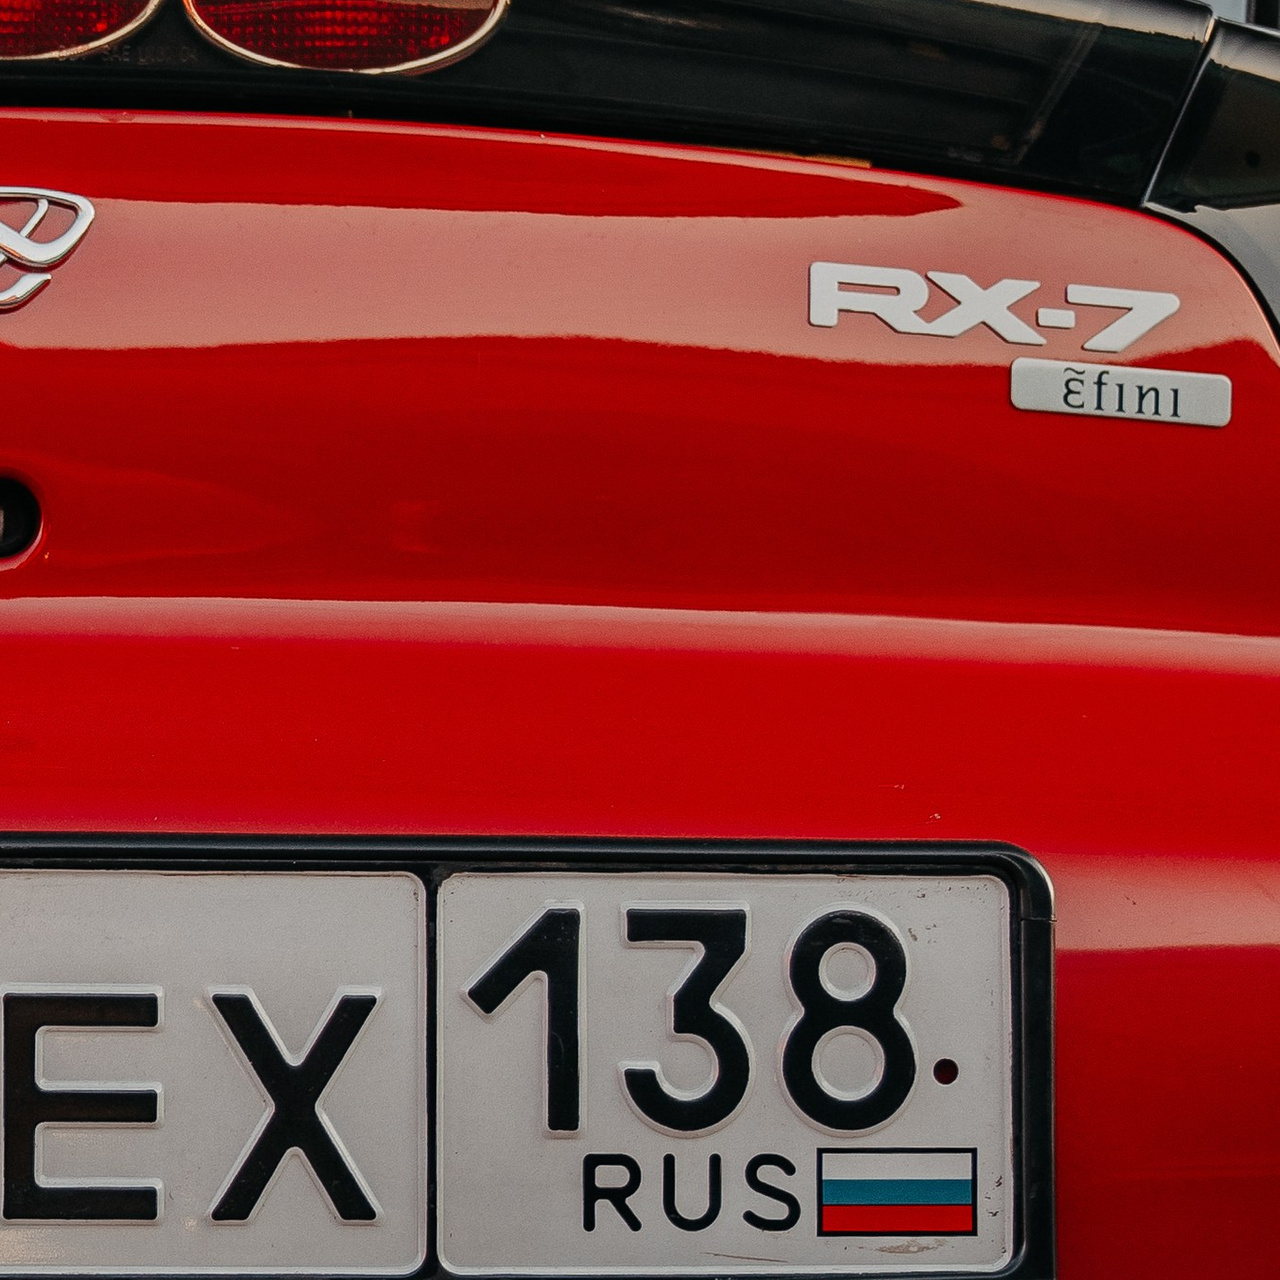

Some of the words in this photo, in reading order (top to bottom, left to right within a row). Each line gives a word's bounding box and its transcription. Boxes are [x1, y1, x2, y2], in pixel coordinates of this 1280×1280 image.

[809, 261, 1180, 352] RX-7
[465, 906, 917, 1132] 138
[582, 1153, 802, 1232] RUS
